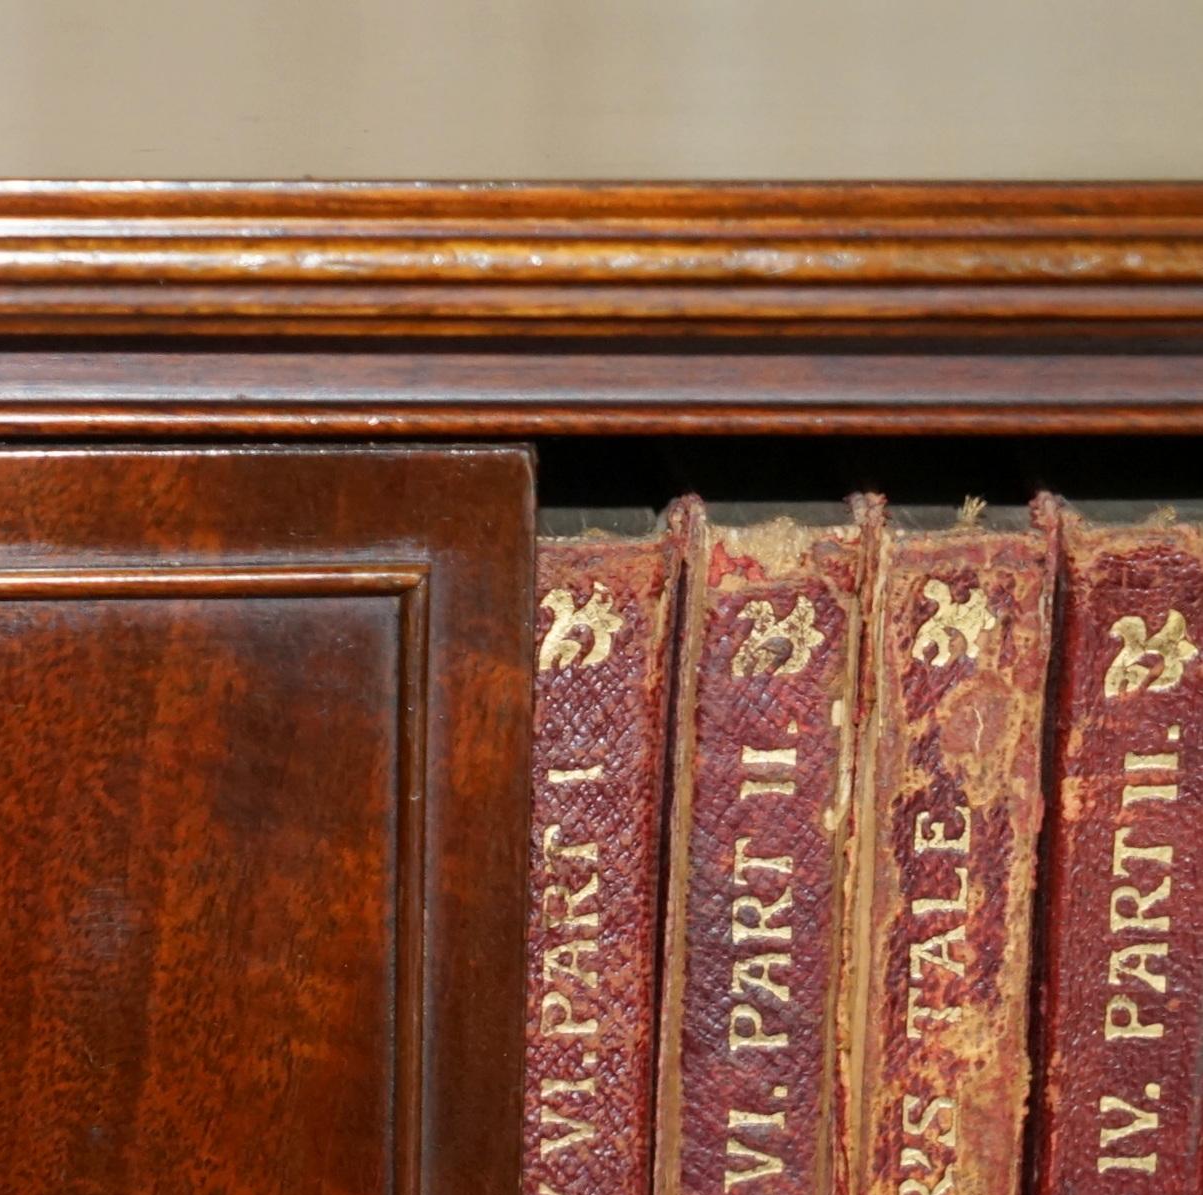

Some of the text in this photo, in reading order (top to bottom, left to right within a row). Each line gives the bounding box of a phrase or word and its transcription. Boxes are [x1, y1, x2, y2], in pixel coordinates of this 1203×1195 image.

[739, 722, 799, 800] II.
[1120, 724, 1181, 809] II.
[729, 837, 794, 1051] PART
[905, 805, 972, 1041] TALE
[1103, 826, 1175, 1042] PART
[723, 1085, 788, 1193] VI.
[1097, 1081, 1163, 1175] IV.
